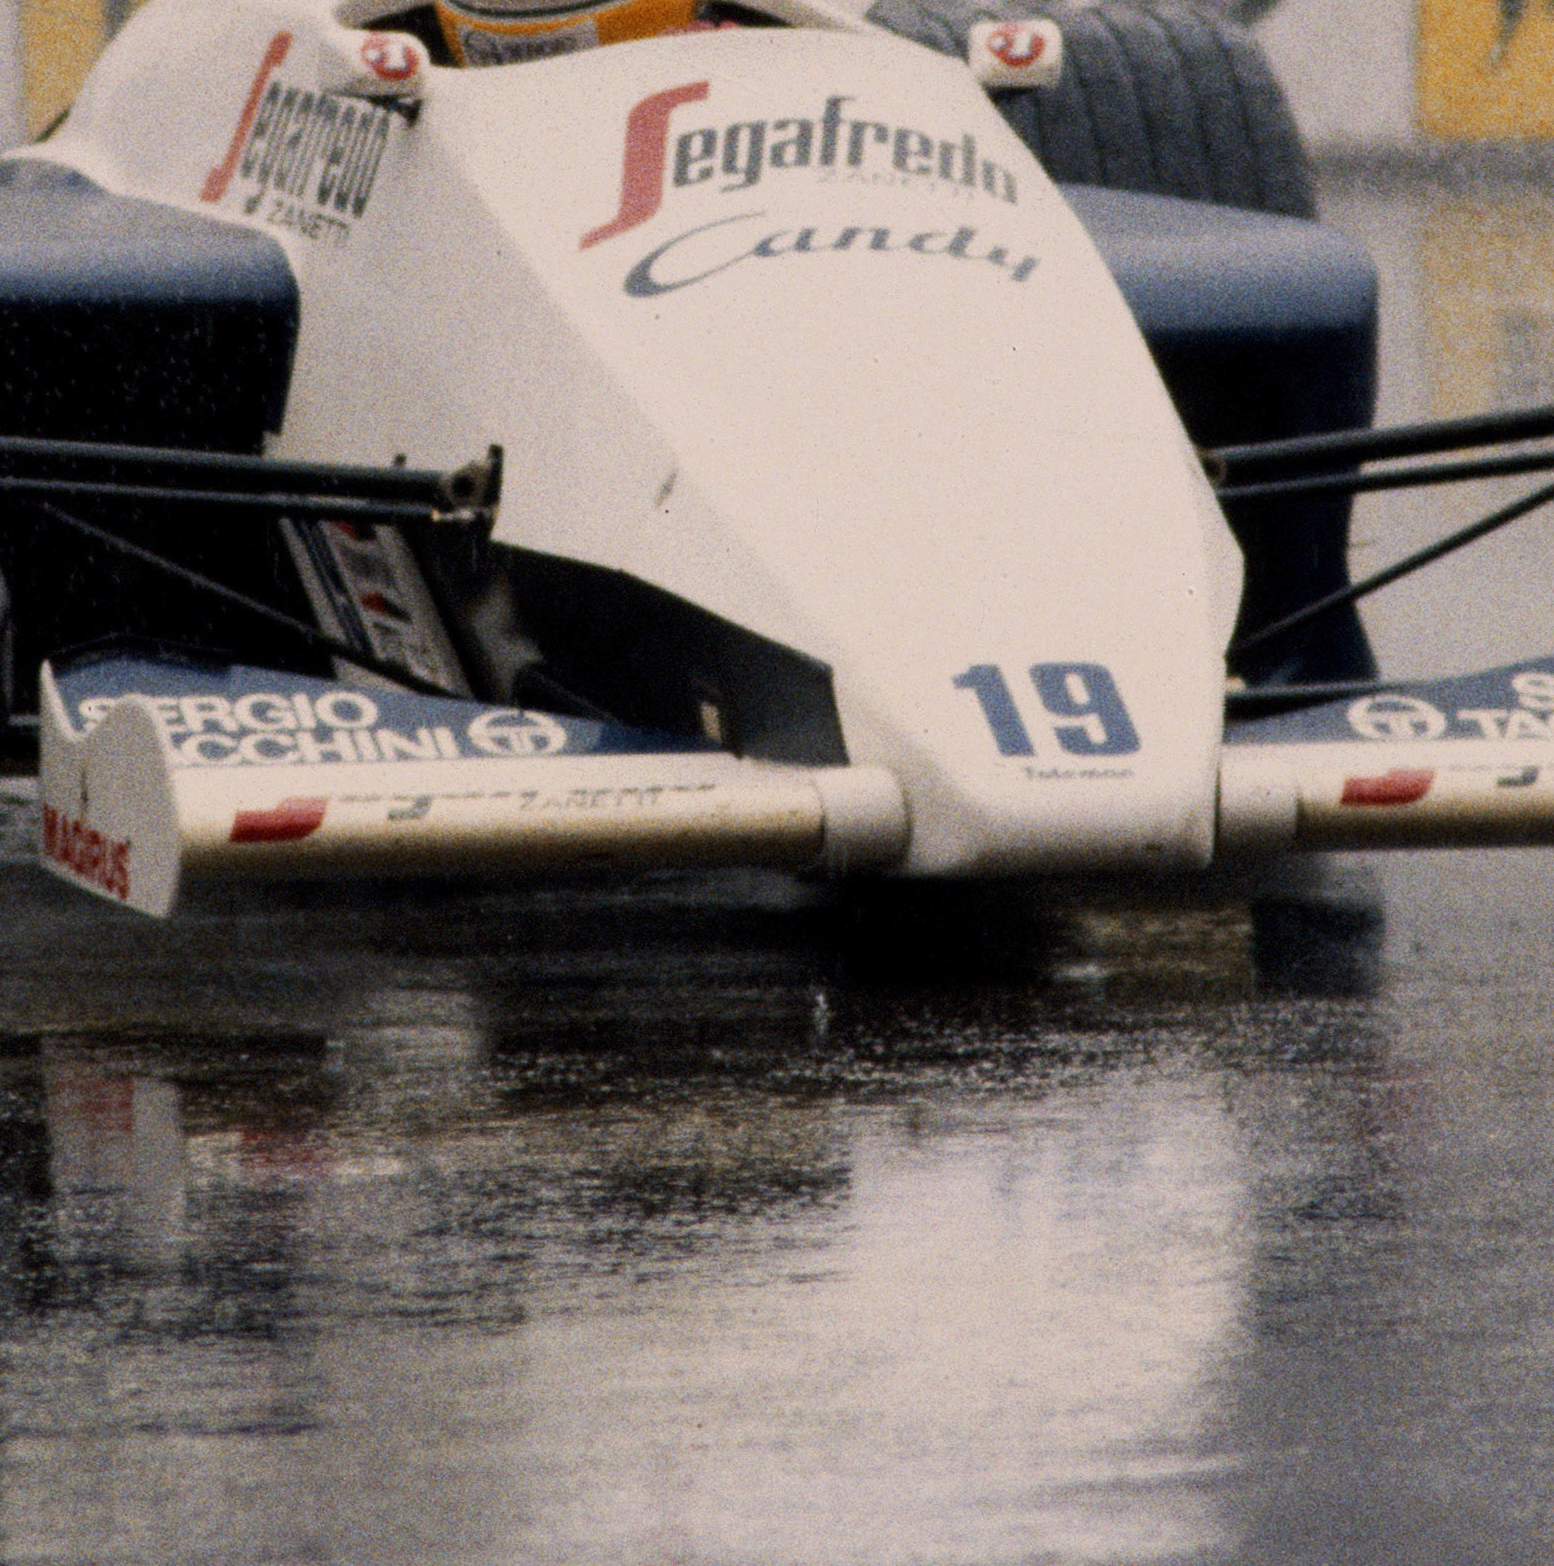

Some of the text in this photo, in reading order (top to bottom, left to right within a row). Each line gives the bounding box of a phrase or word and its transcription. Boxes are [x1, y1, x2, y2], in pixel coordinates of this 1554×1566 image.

[577, 79, 1019, 252] Segafredo
[622, 209, 1042, 298] Candy
[167, 726, 463, 766] CCHINI
[952, 661, 1143, 757] 19
